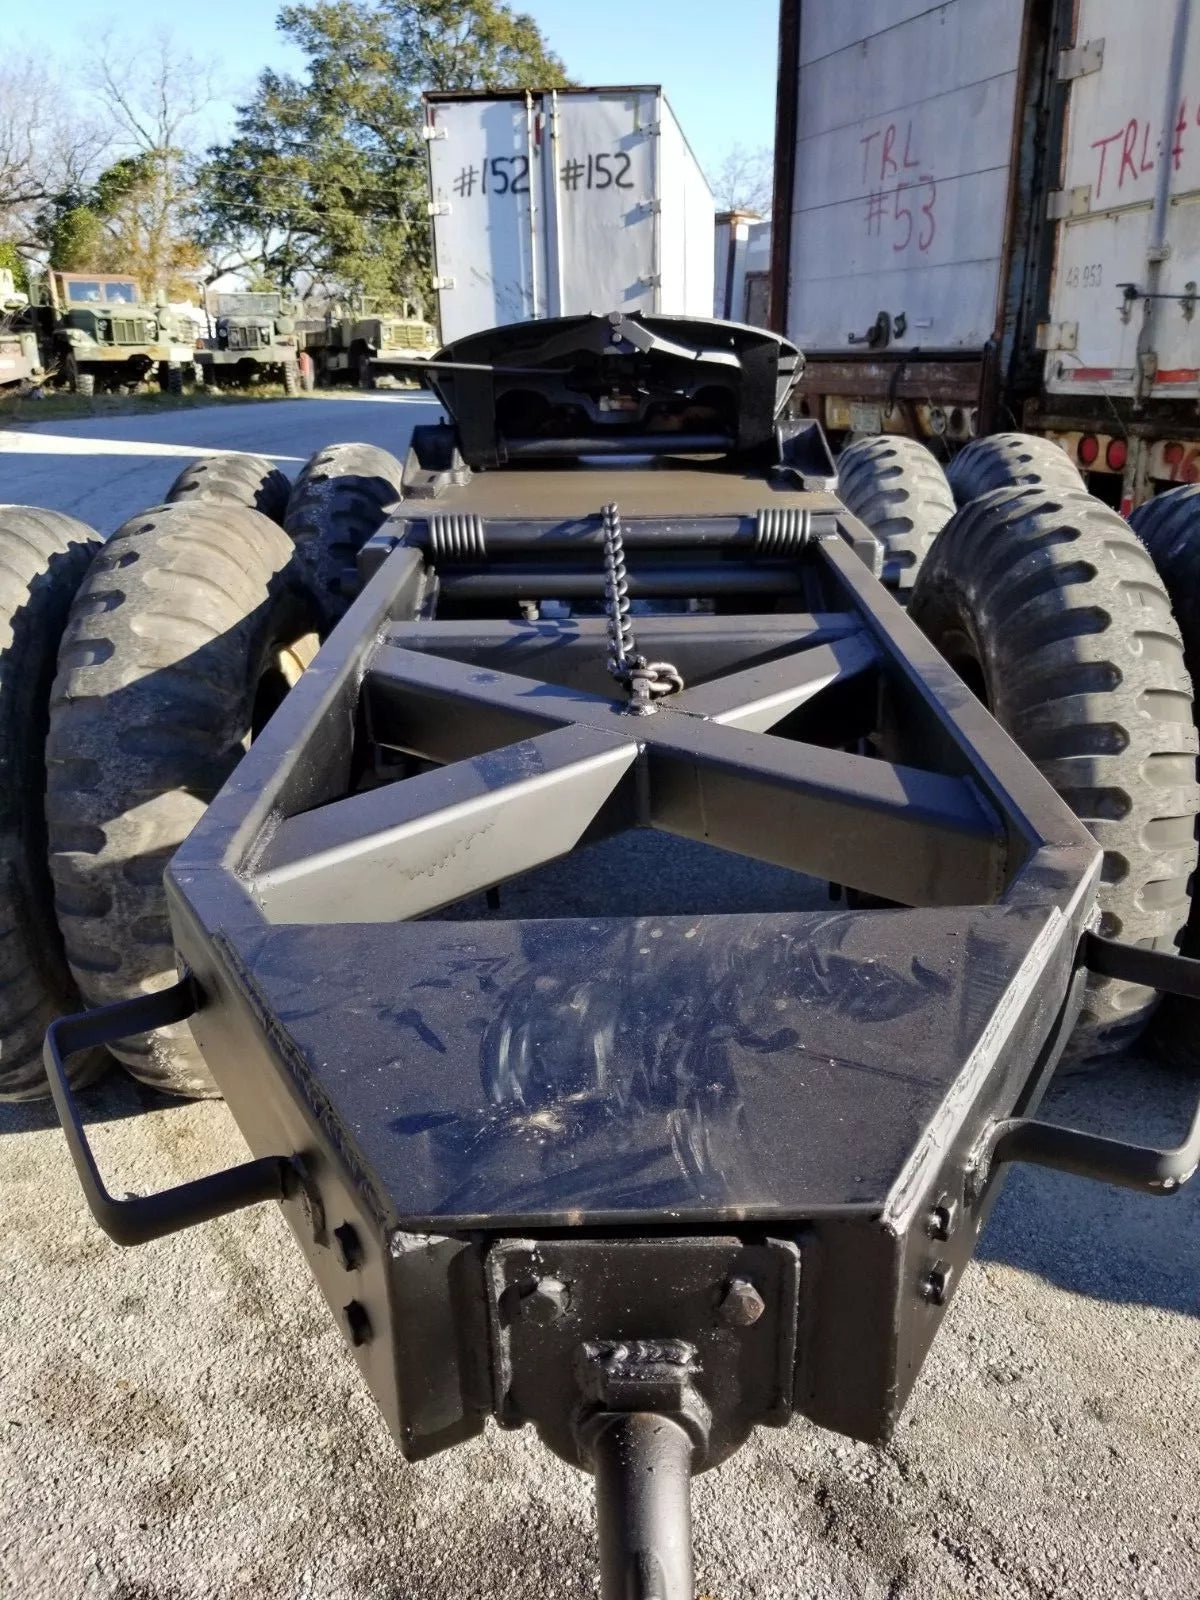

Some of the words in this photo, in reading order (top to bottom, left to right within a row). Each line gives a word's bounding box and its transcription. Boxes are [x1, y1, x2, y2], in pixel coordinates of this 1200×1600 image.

[453, 156, 529, 197] #152
[560, 153, 634, 191] #152
[860, 120, 920, 184] TRL
[1091, 118, 1154, 198] TRL
[863, 175, 936, 251] #53
